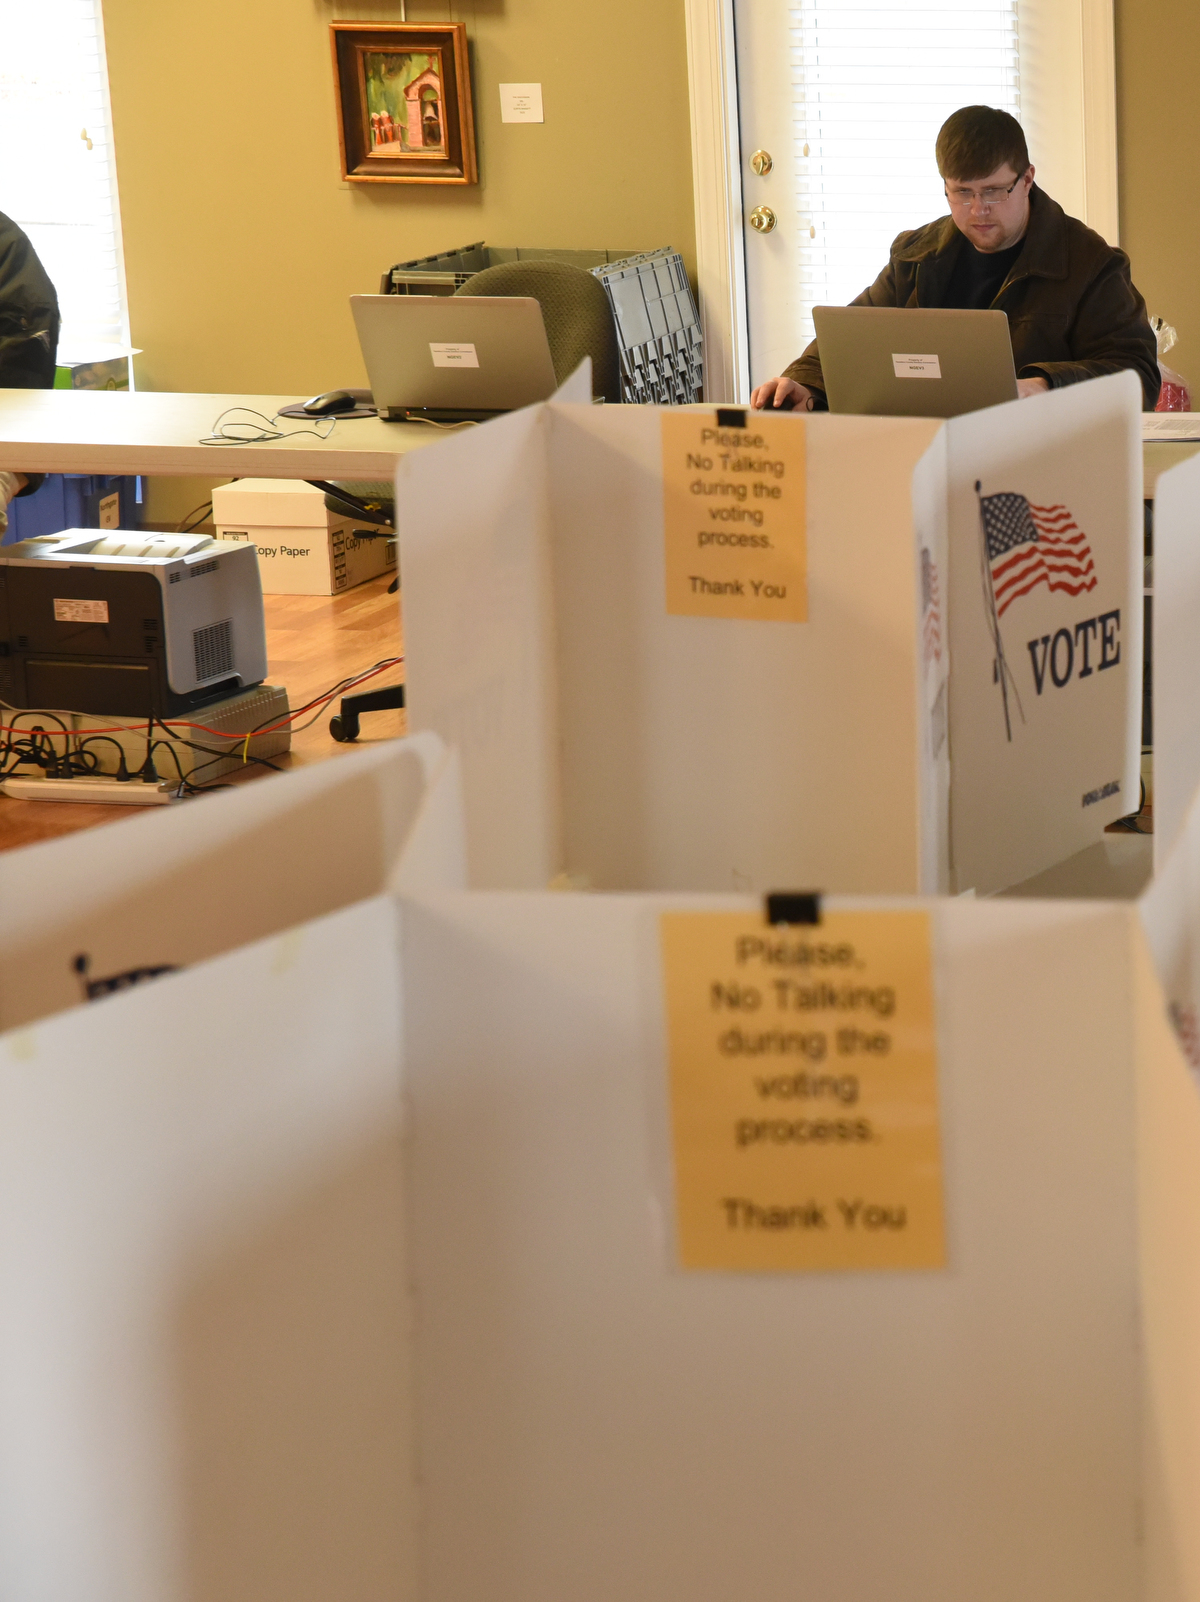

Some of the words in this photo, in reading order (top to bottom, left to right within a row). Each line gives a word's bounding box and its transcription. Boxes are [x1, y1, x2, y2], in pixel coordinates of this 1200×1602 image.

[701, 428, 769, 450] Please,
[686, 454, 713, 470] No
[719, 454, 784, 479] Talking
[690, 481, 747, 500] during
[753, 483, 782, 498] the
[708, 506, 763, 527] voting
[280, 545, 310, 559] Paper
[698, 532, 774, 548] process.
[689, 577, 744, 596] Thank
[751, 581, 787, 599] You
[1027, 609, 1120, 696] VOTE
[709, 981, 761, 1013] No
[774, 980, 896, 1018] Talking
[718, 1026, 827, 1060] during
[836, 1028, 891, 1056] the
[755, 1070, 858, 1105] voting
[735, 1116, 881, 1151] process.
[722, 1198, 827, 1230] Thank
[838, 1202, 907, 1231] You
